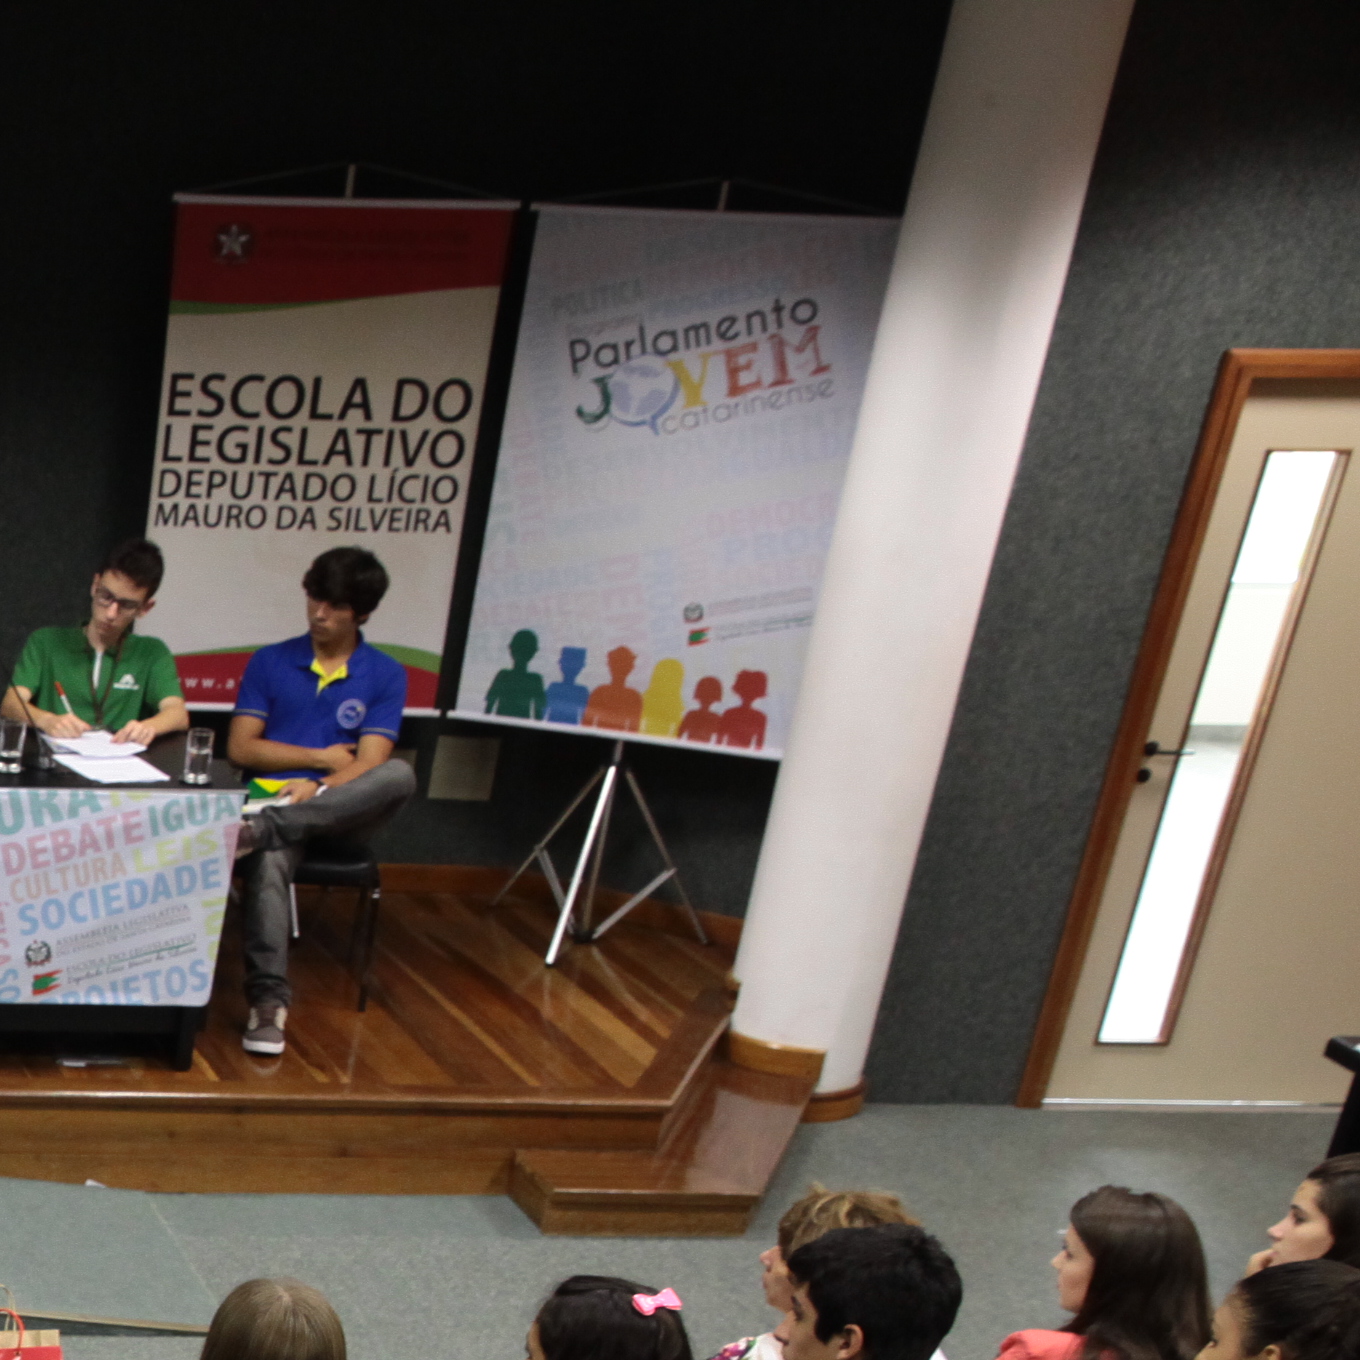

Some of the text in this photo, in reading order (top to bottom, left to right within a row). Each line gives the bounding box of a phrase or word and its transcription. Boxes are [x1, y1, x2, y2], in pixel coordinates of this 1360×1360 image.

[568, 296, 819, 377] Parlamento
[166, 372, 473, 423] ESCOLA DO
[660, 378, 835, 436] catarinense
[161, 423, 466, 470] LEGISLATIVO
[157, 468, 459, 505] DEPUTADO LÍCIO
[153, 502, 452, 534] MAURO DA SILVEIRA
[0, 808, 145, 877] DEBATE
[131, 828, 219, 873] LEIS
[9, 851, 127, 904] CULTURA
[17, 857, 223, 936] SOCIEDADE
